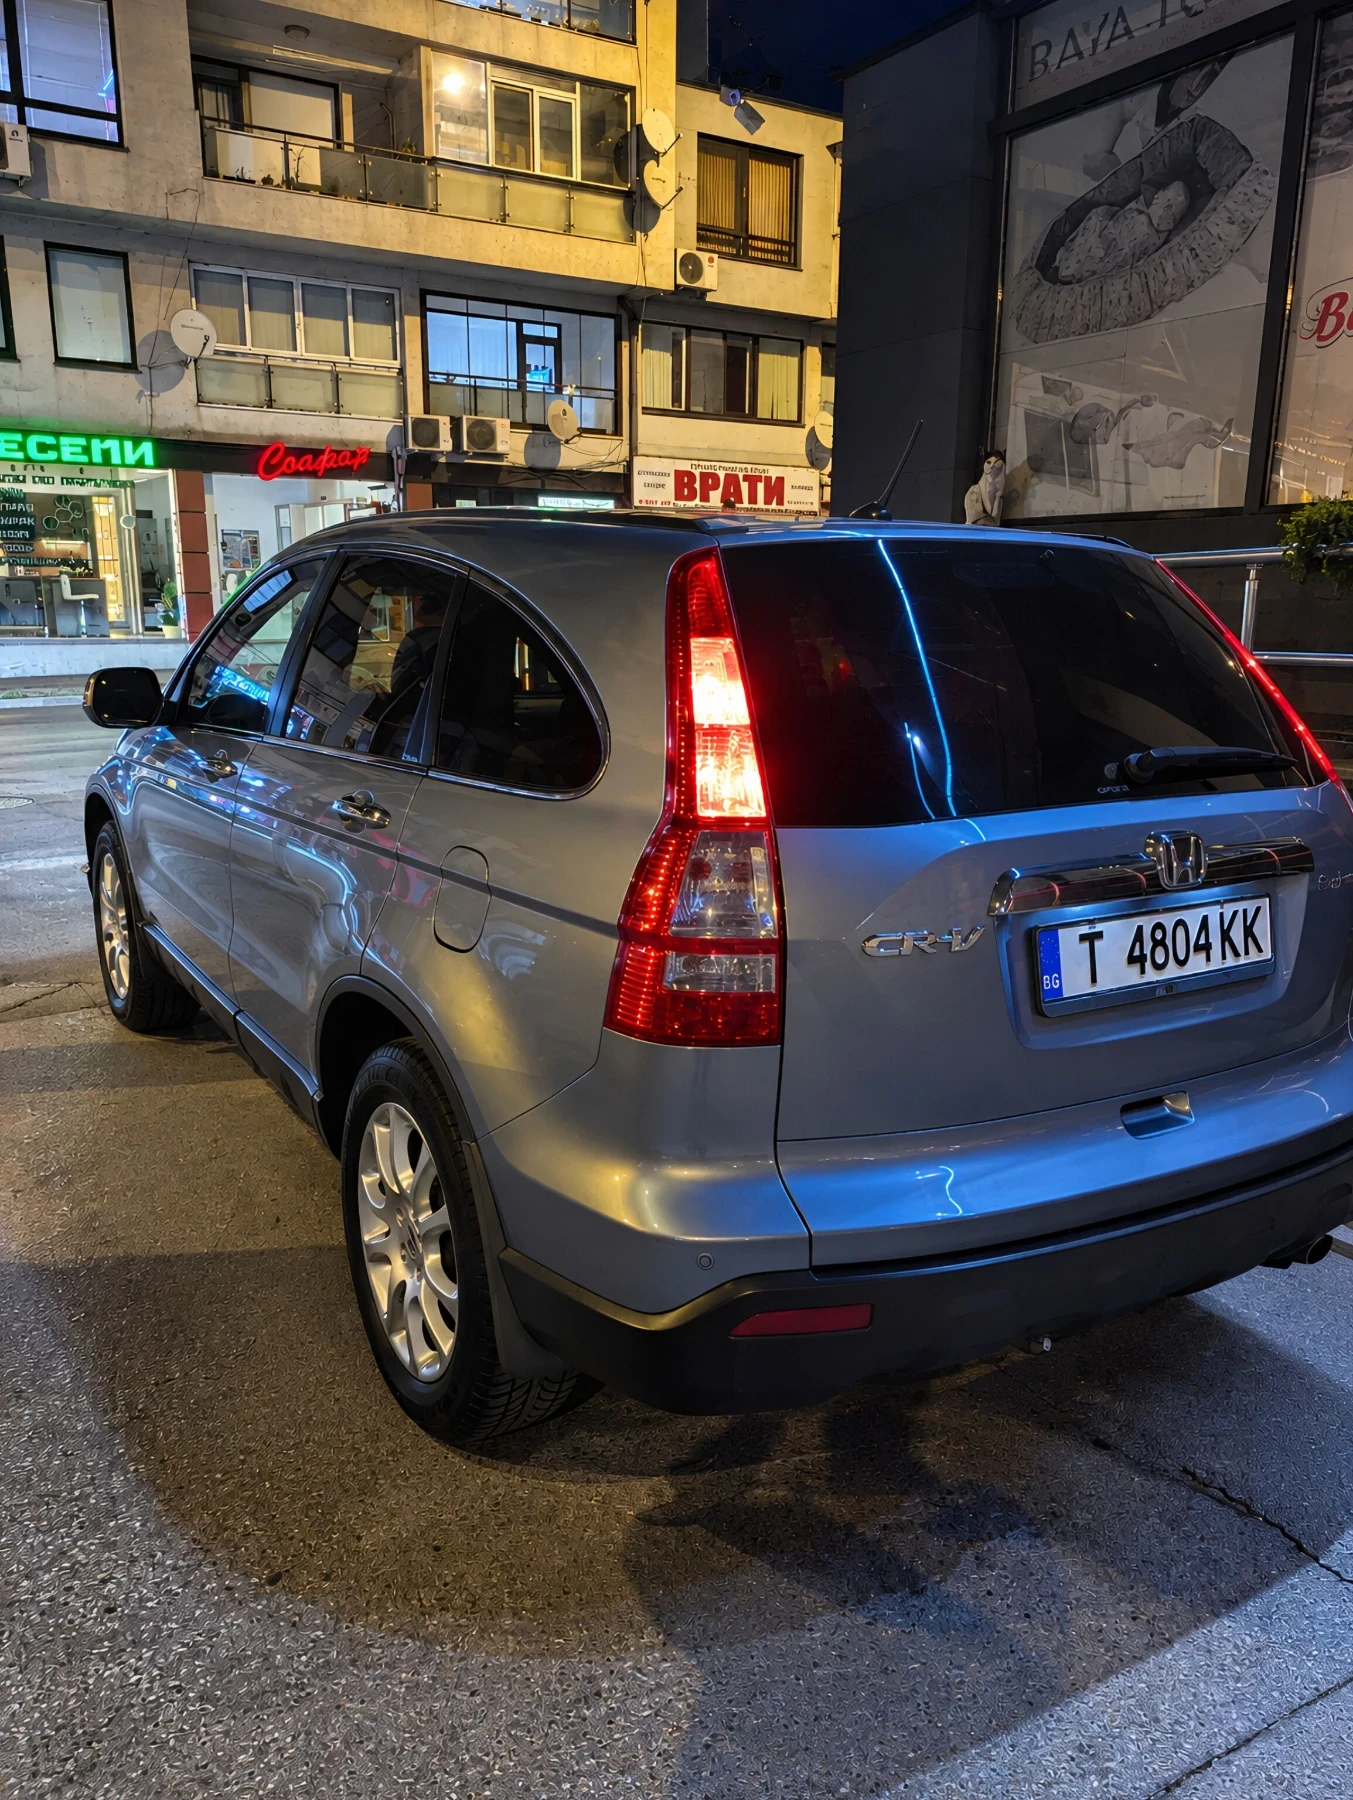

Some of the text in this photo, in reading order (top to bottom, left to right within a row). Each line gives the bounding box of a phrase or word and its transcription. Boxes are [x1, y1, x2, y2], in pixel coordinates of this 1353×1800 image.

[1027, 6, 1136, 82] BAYA
[674, 469, 785, 506] ВРАТИ
[861, 924, 986, 957] CR-V
[1078, 930, 1104, 985] T
[1043, 973, 1061, 990] BG
